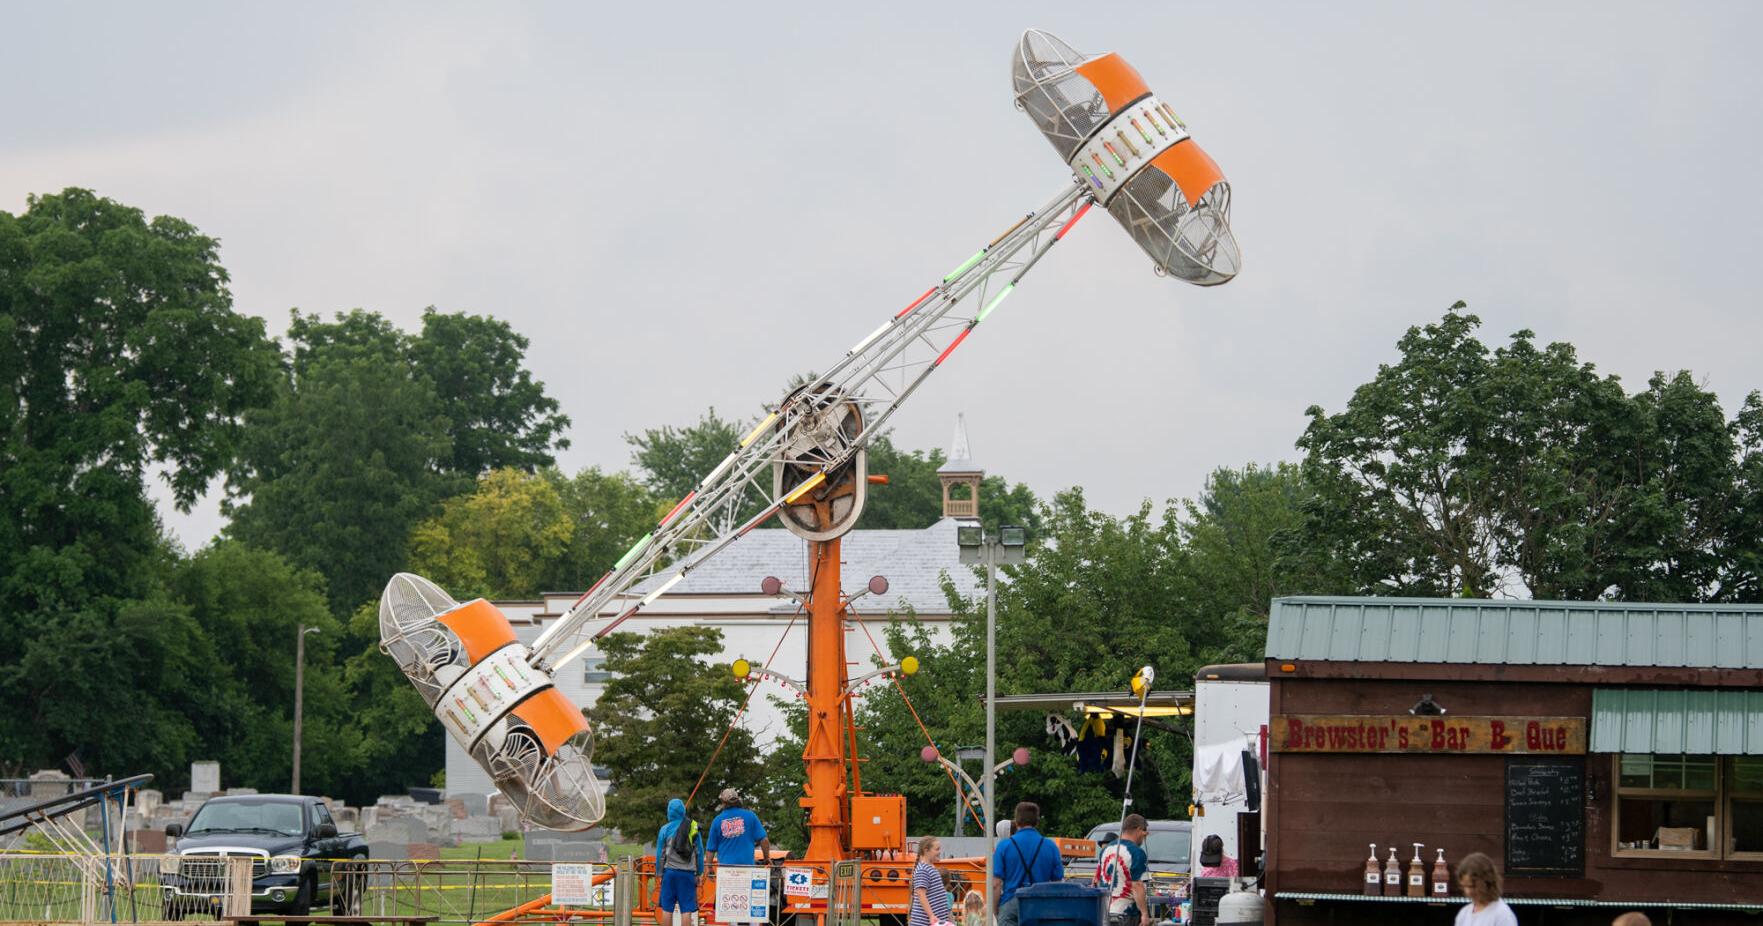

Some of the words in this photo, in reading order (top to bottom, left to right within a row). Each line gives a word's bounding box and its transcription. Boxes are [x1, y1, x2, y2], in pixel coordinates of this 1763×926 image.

[1287, 718, 1408, 749] Brewster's
[1430, 719, 1470, 749] Bar
[1526, 720, 1566, 750] Que
